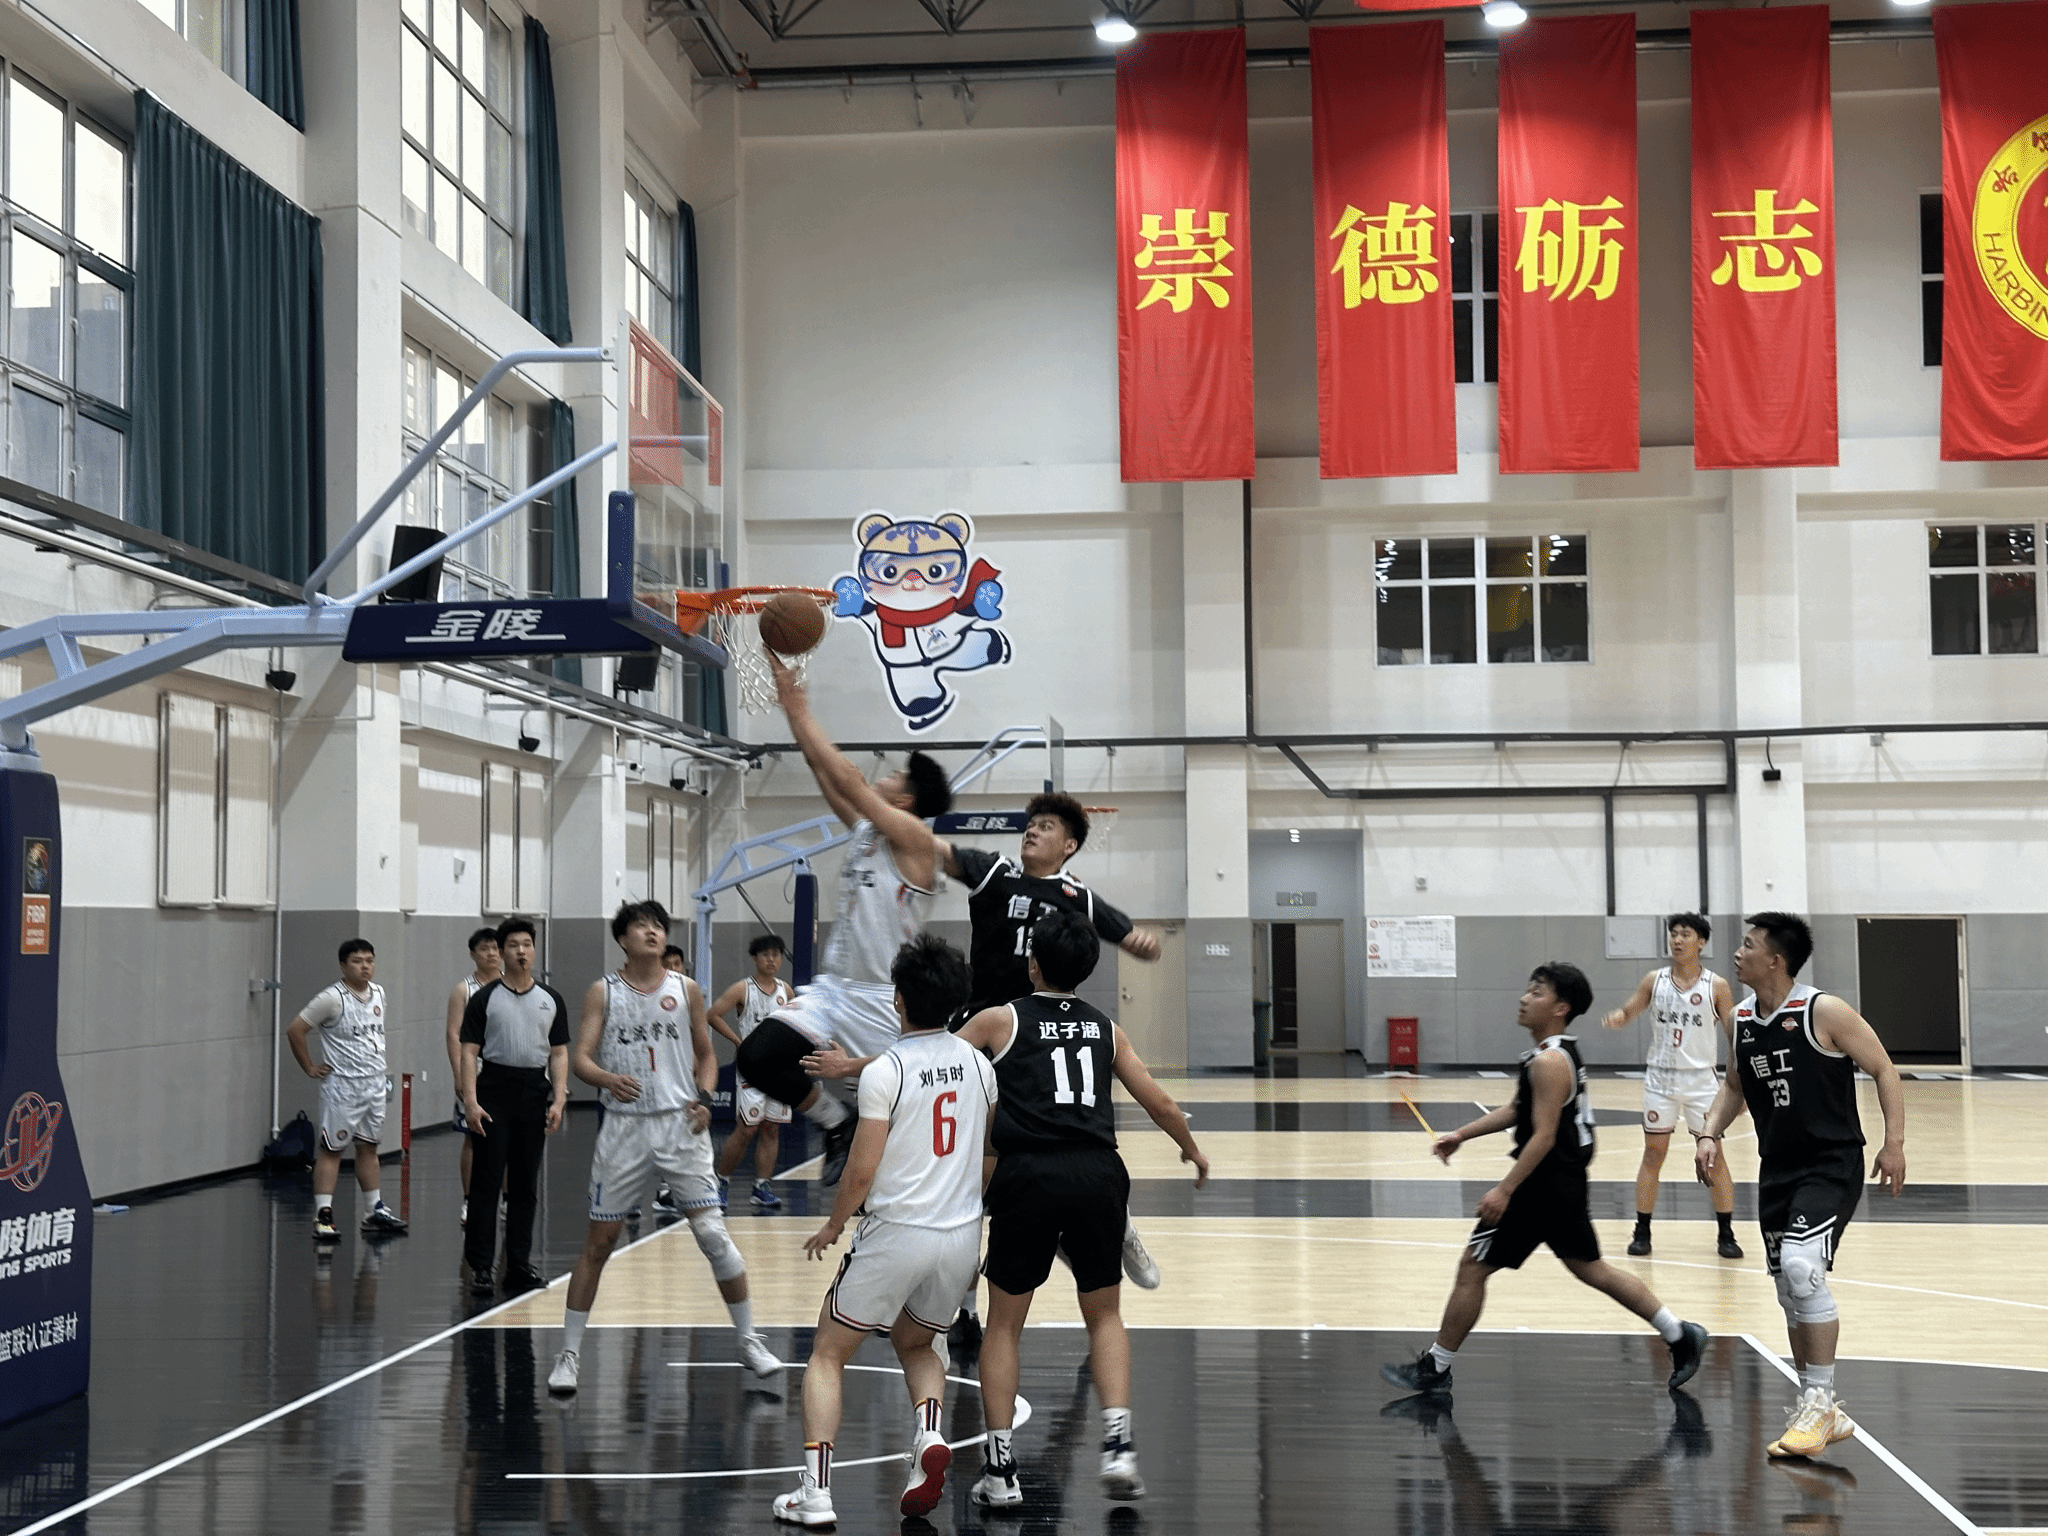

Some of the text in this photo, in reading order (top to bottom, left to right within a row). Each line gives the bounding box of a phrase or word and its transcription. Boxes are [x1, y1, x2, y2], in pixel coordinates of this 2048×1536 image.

[1135, 190, 1822, 313] 崇 德 砺 志
[405, 609, 566, 643] 金陵
[1039, 1021, 1101, 1040] 迟子涵
[1673, 1028, 1683, 1048] 9
[919, 1063, 964, 1088] 刘与时
[1051, 1046, 1097, 1108] 11
[1750, 1048, 1794, 1079] 信工
[933, 1090, 957, 1157] 6
[23, 1248, 72, 1273] SPORTS
